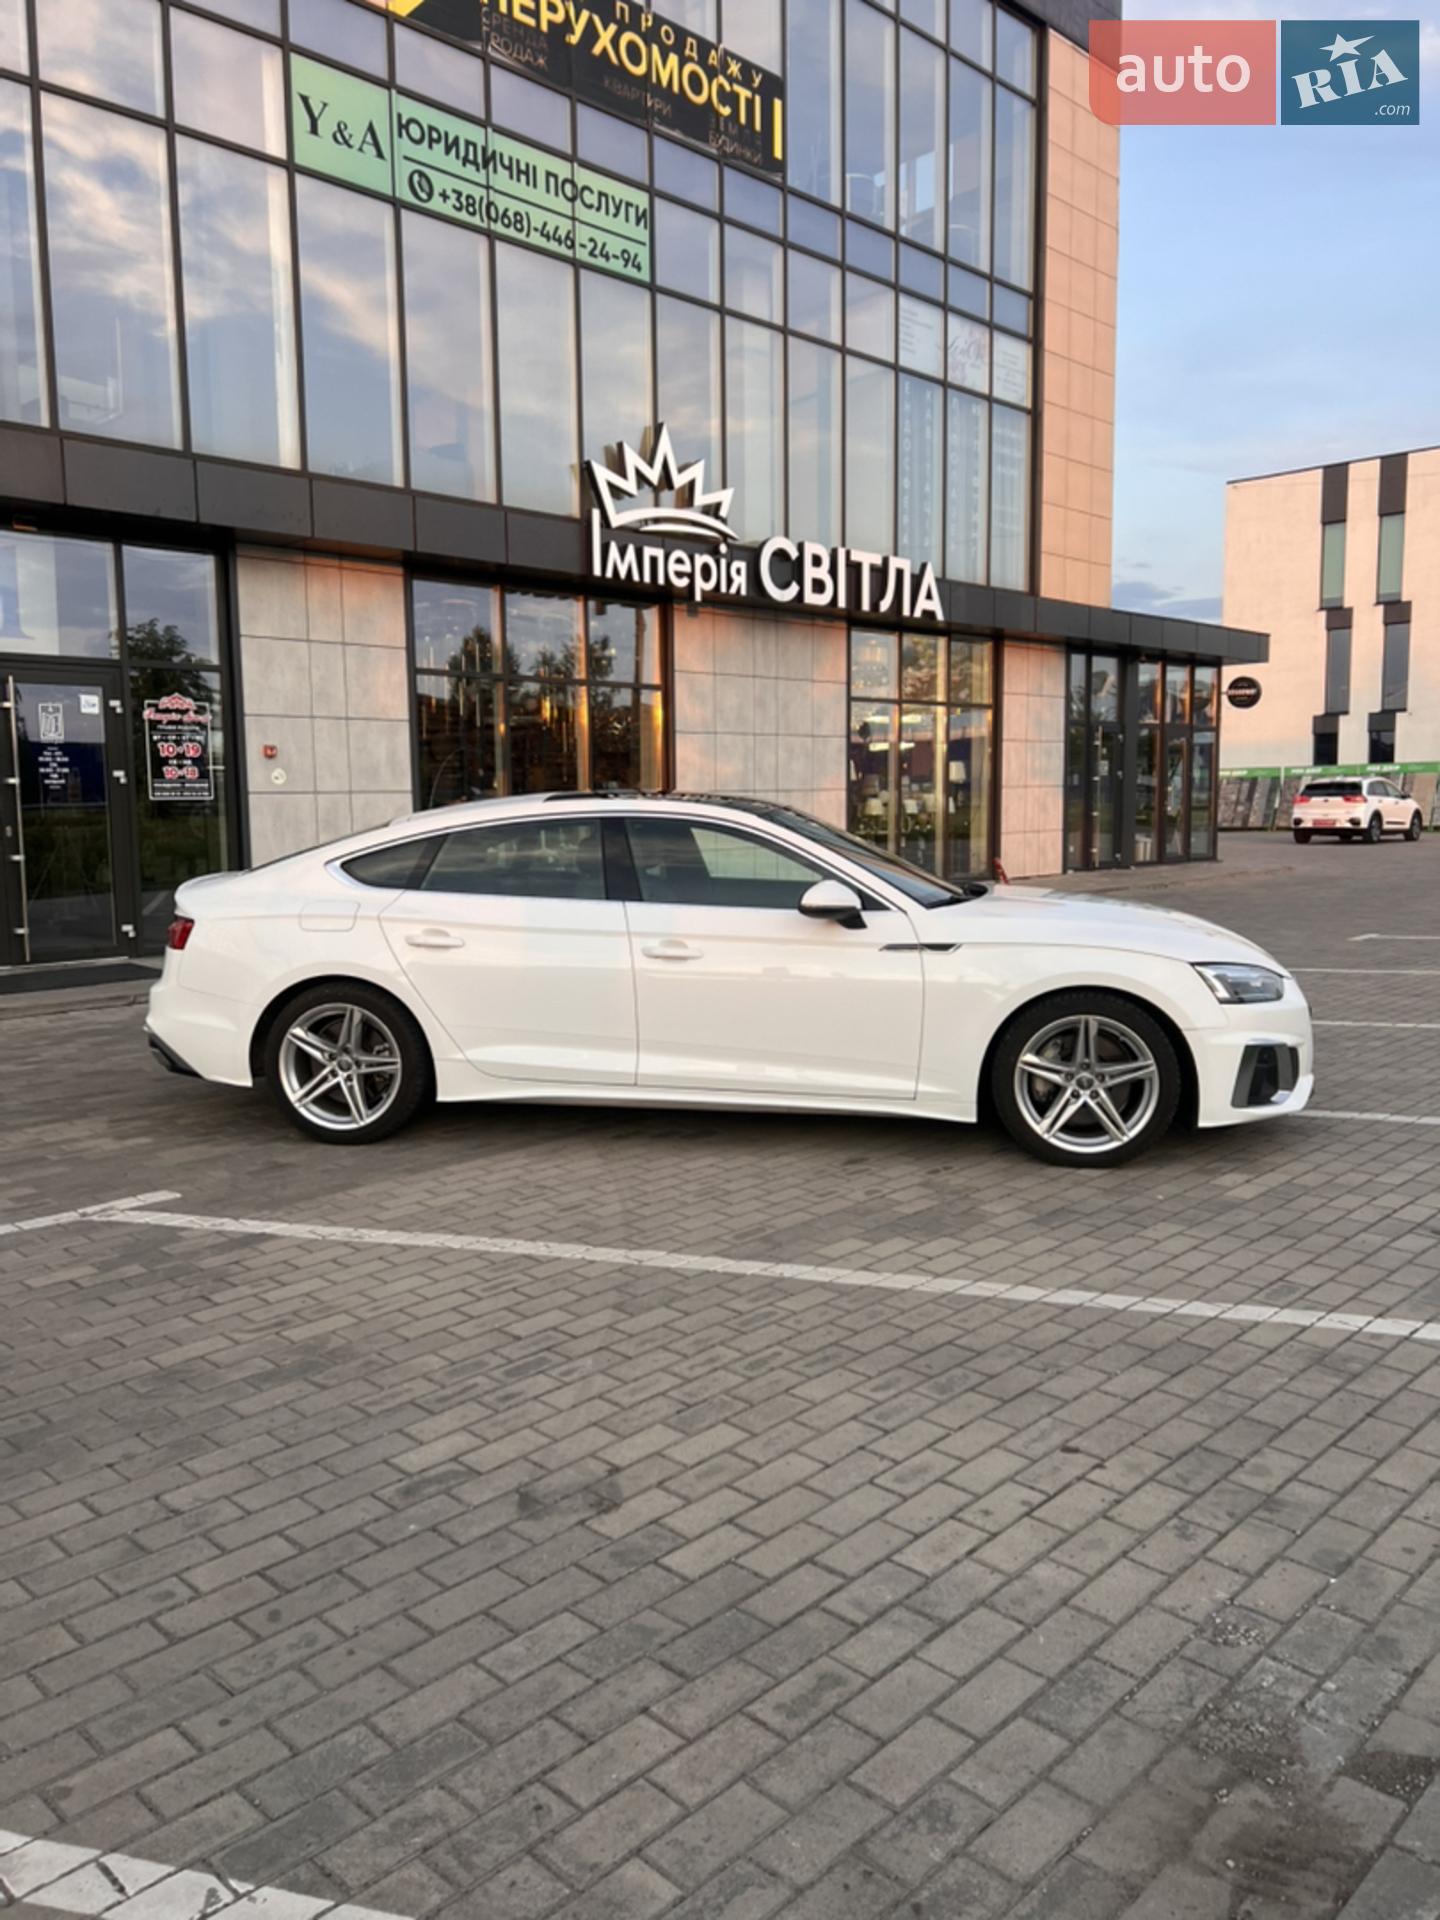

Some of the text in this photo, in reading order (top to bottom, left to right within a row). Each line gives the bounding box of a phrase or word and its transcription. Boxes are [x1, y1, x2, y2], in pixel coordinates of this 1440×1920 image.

[618, 2, 763, 87] ПРОДАЖУ
[604, 74, 672, 118] КВАРТИРИ
[398, 111, 649, 231] ЮРИДИЧНІ ПОСЛУГИ
[592, 508, 945, 621] Імперія СВІТЛА
